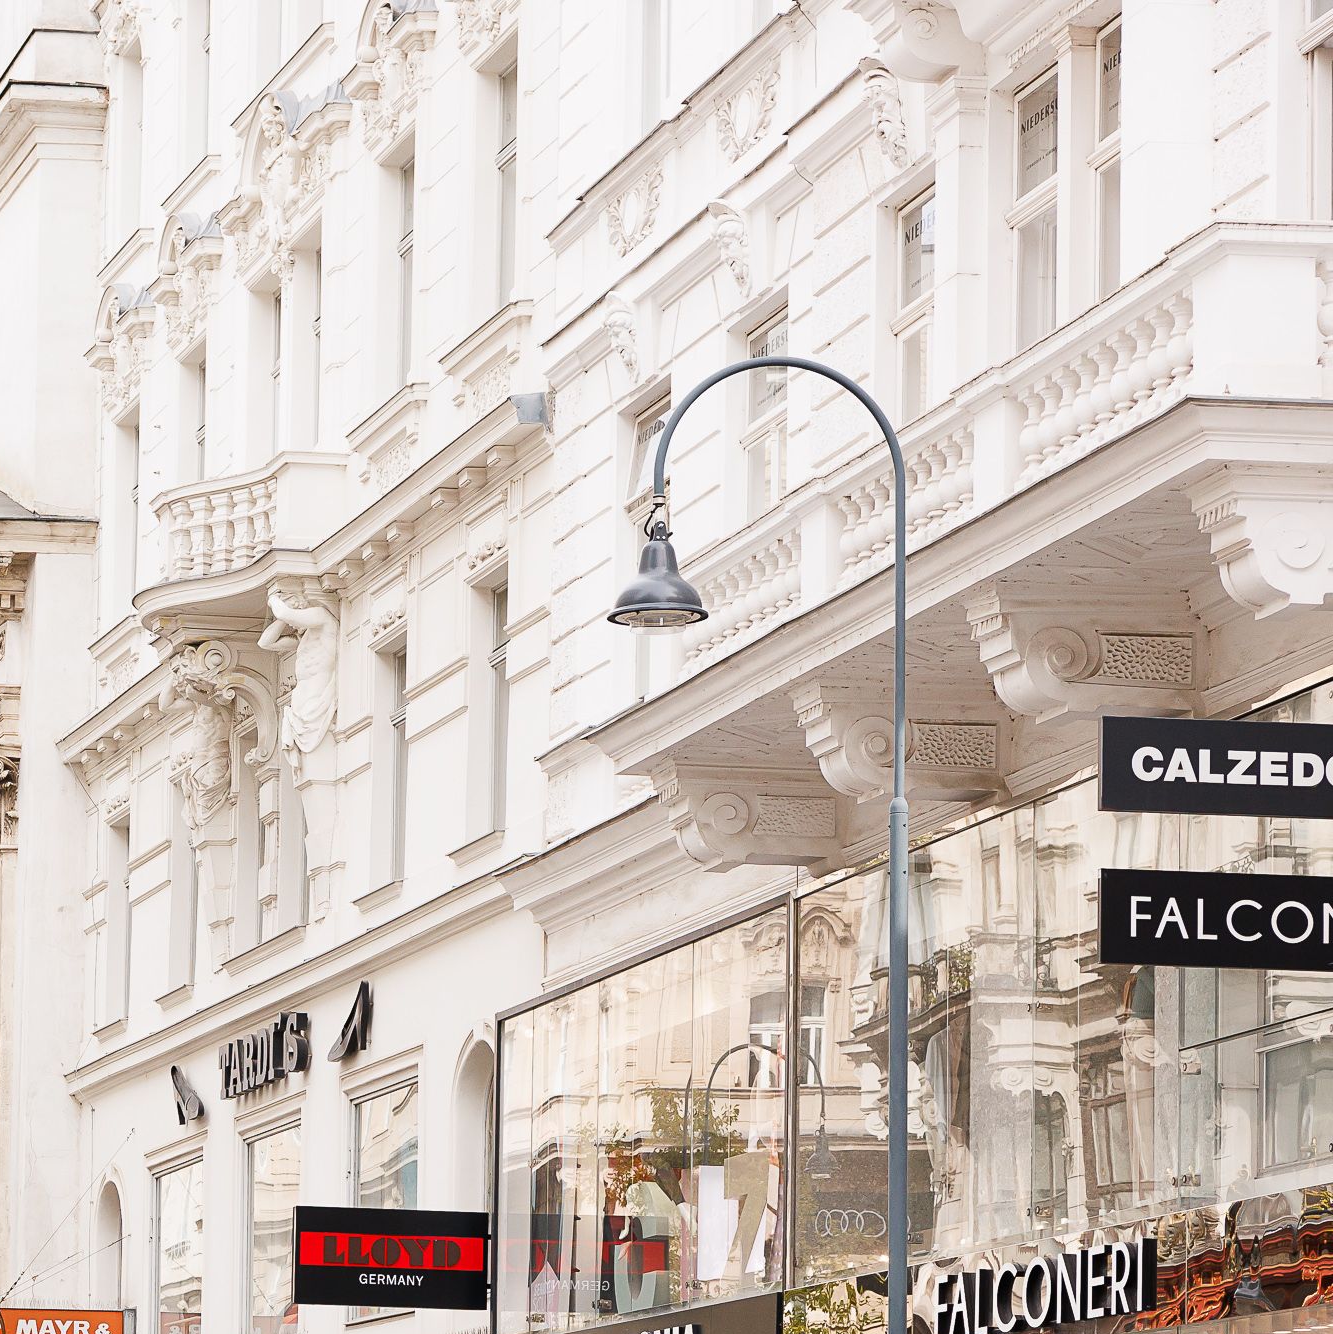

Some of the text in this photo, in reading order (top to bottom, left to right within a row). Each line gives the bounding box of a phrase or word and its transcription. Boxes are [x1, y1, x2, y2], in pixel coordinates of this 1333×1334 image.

[1131, 746, 1333, 787] CALZED
[218, 1011, 310, 1100] TARDI'S
[323, 1235, 462, 1268] LLOYD
[358, 1273, 424, 1287] GERMANY
